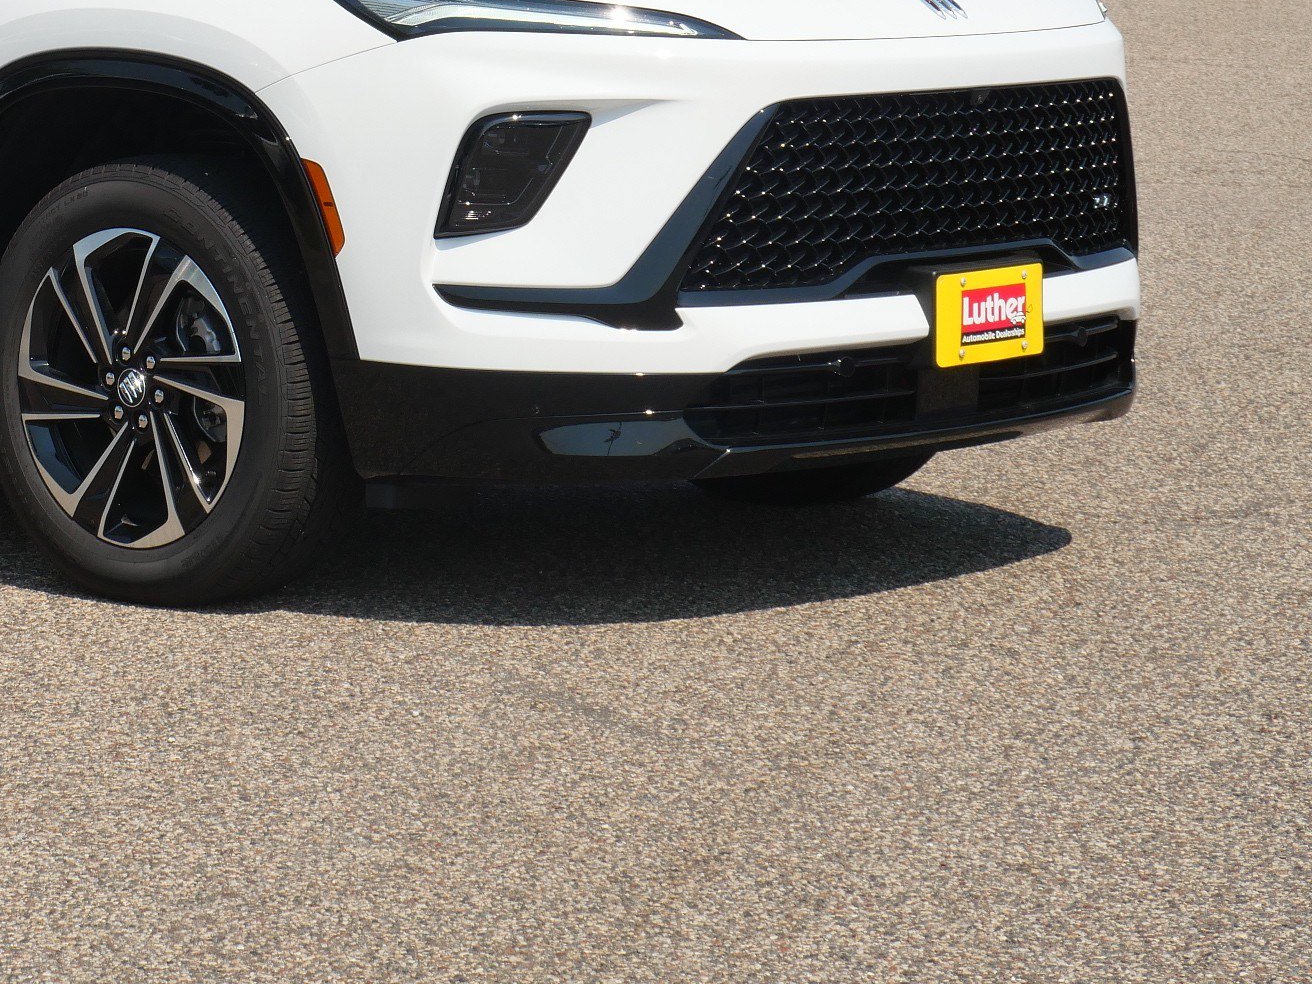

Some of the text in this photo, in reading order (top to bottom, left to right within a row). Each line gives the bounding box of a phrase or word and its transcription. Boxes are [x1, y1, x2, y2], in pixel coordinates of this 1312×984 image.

[963, 292, 1025, 326] Luther
[962, 328, 1025, 343] Automobile Dealerships
